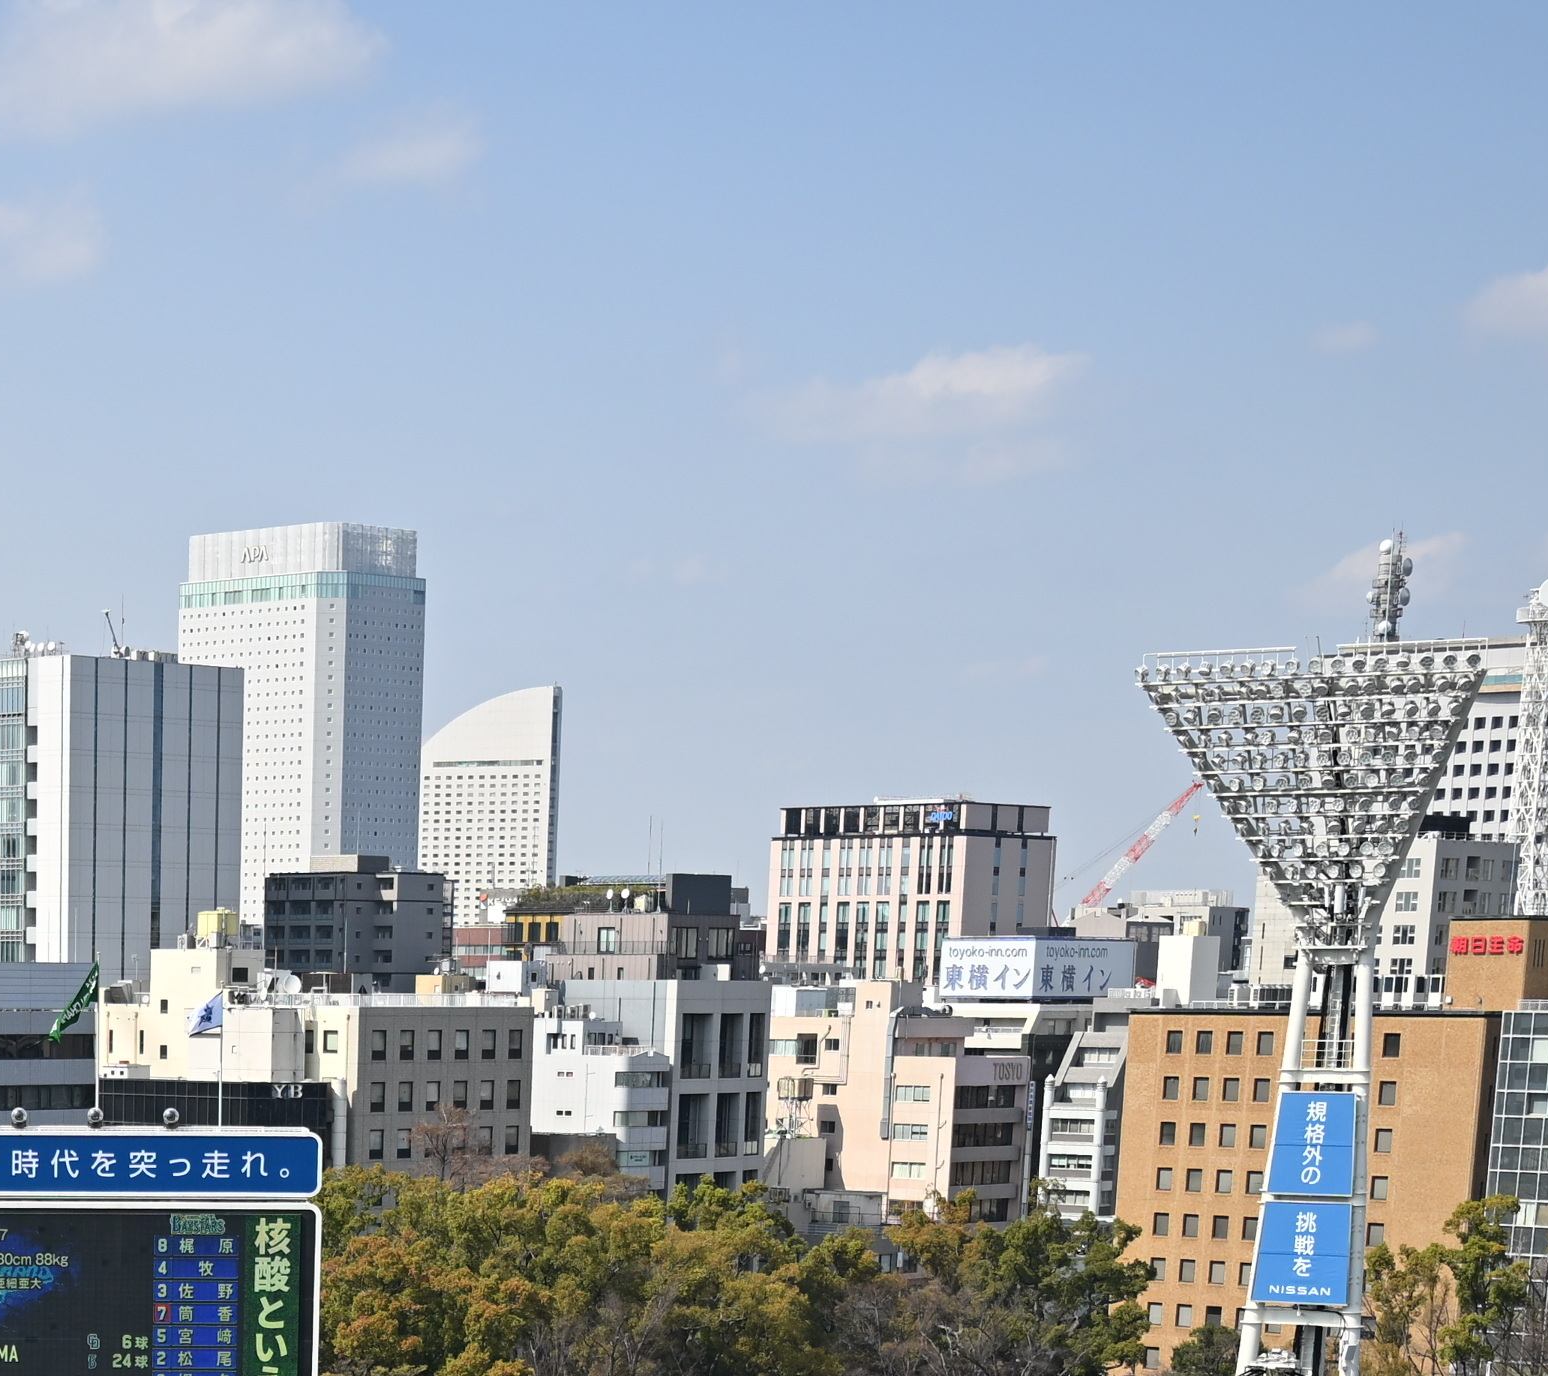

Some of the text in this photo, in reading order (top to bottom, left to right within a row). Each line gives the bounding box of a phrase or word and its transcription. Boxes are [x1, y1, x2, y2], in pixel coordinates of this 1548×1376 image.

[949, 945, 1028, 960] toyoko-inn.com
[1046, 945, 1108, 961] toyoko-inn.com
[1451, 935, 1524, 955] 朝日生命
[943, 964, 1031, 991] 東横イン
[1039, 965, 1112, 993] 東横イン
[993, 1062, 1022, 1081] TOSYO
[273, 1084, 303, 1099] YB
[1300, 1101, 1327, 1185] 規格外の
[1292, 1211, 1317, 1277] 挑戦を
[35, 1253, 69, 1267] 88kg
[198, 1260, 214, 1277] 牧
[1269, 1285, 1331, 1296] NISSAN
